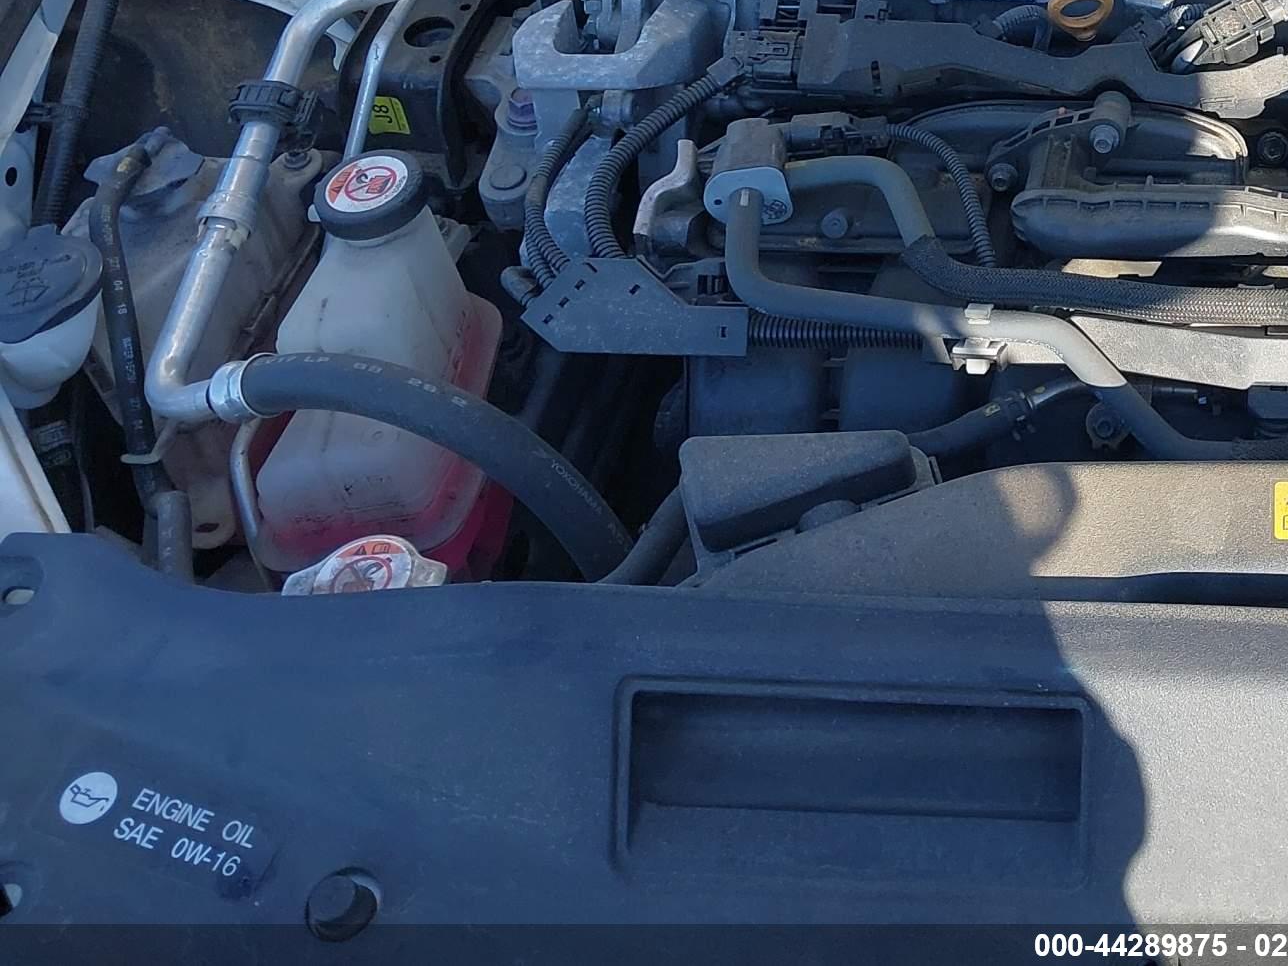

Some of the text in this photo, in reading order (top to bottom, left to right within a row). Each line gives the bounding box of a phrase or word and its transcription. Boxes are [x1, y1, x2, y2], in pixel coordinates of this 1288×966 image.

[113, 817, 241, 876] SAE 0W-16
[132, 788, 254, 849] ENGINE OIL
